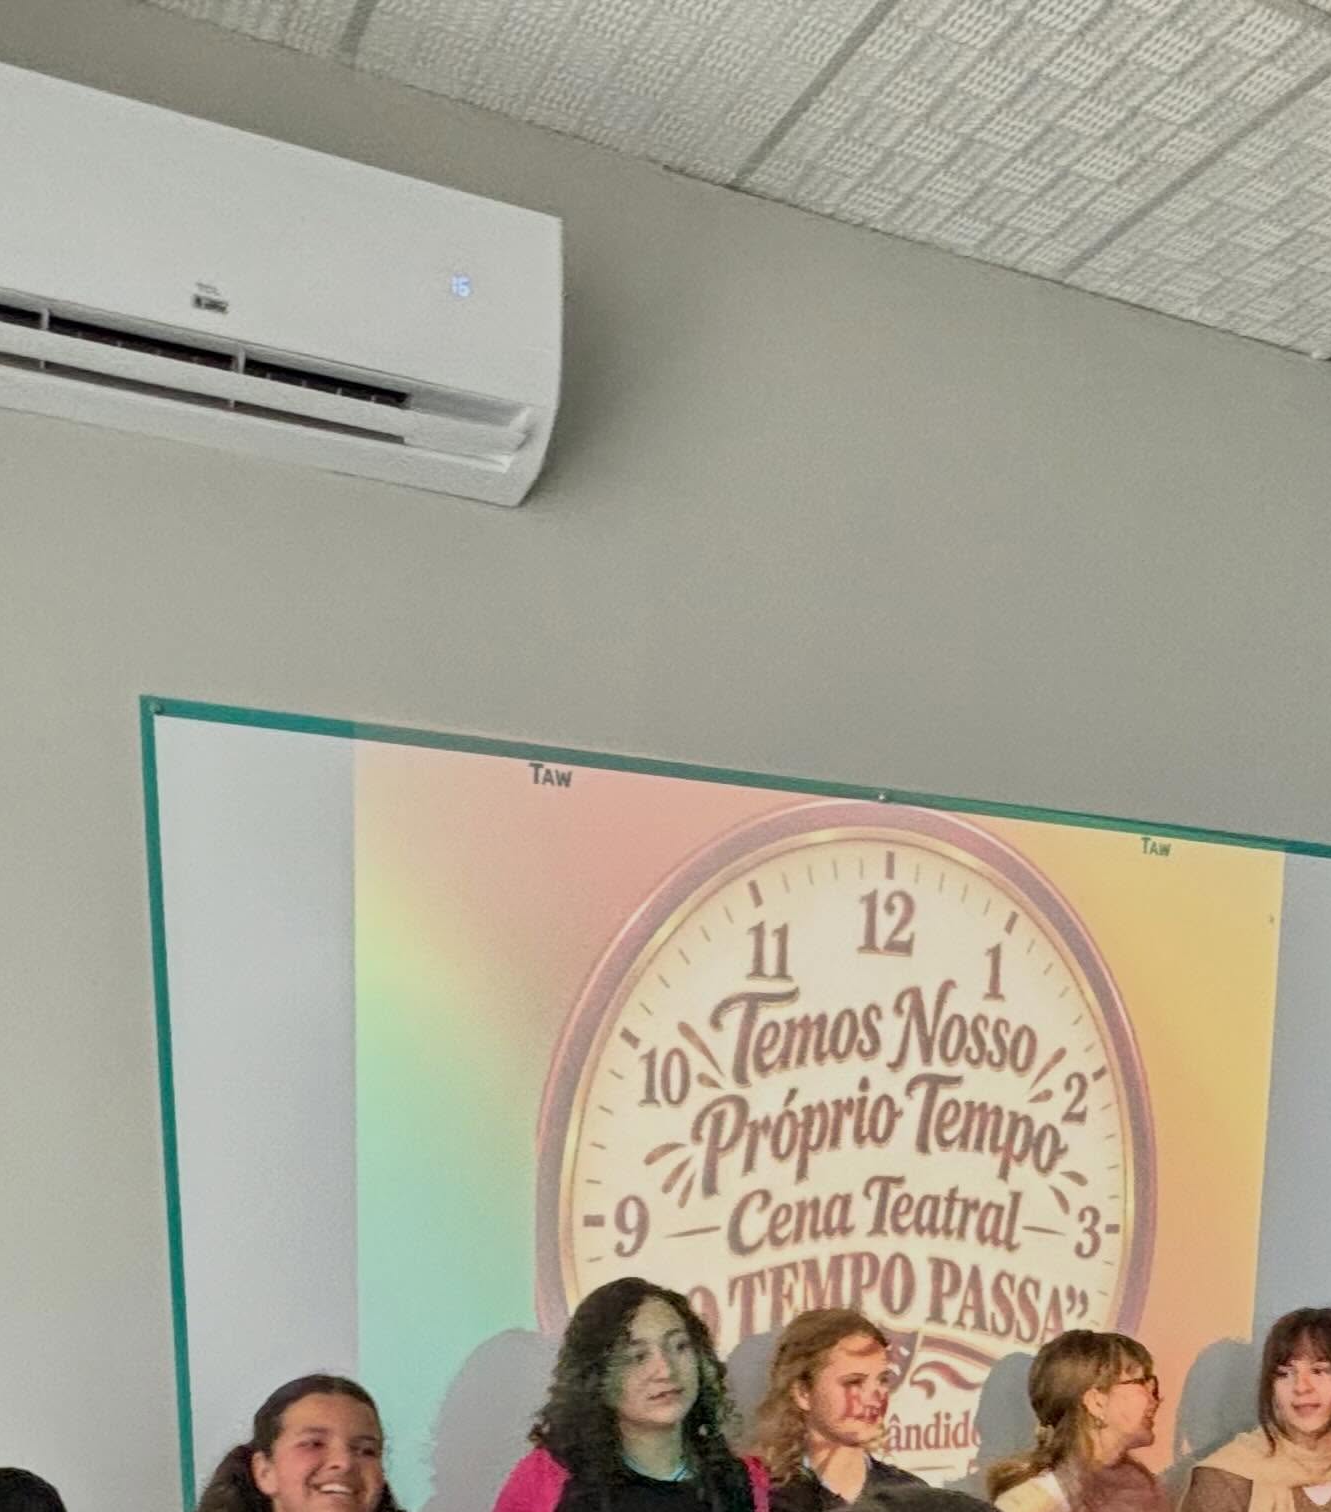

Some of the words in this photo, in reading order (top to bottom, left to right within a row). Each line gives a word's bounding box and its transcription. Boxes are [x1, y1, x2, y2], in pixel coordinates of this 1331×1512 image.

[747, 922, 794, 983] 11
[858, 890, 915, 957] 12
[984, 944, 1005, 1001] 1
[710, 986, 883, 1087] Temos
[886, 979, 1038, 1073] Nosso
[638, 1046, 691, 1108] 10
[1061, 1072, 1090, 1124] 2
[691, 1076, 904, 1197] Próprio
[905, 1073, 1069, 1182] Tempo
[614, 1195, 650, 1257] 9
[727, 1188, 856, 1256] Cena
[862, 1175, 1023, 1253] Teatral
[1074, 1205, 1102, 1259] 3
[728, 1252, 916, 1337] TEMPO
